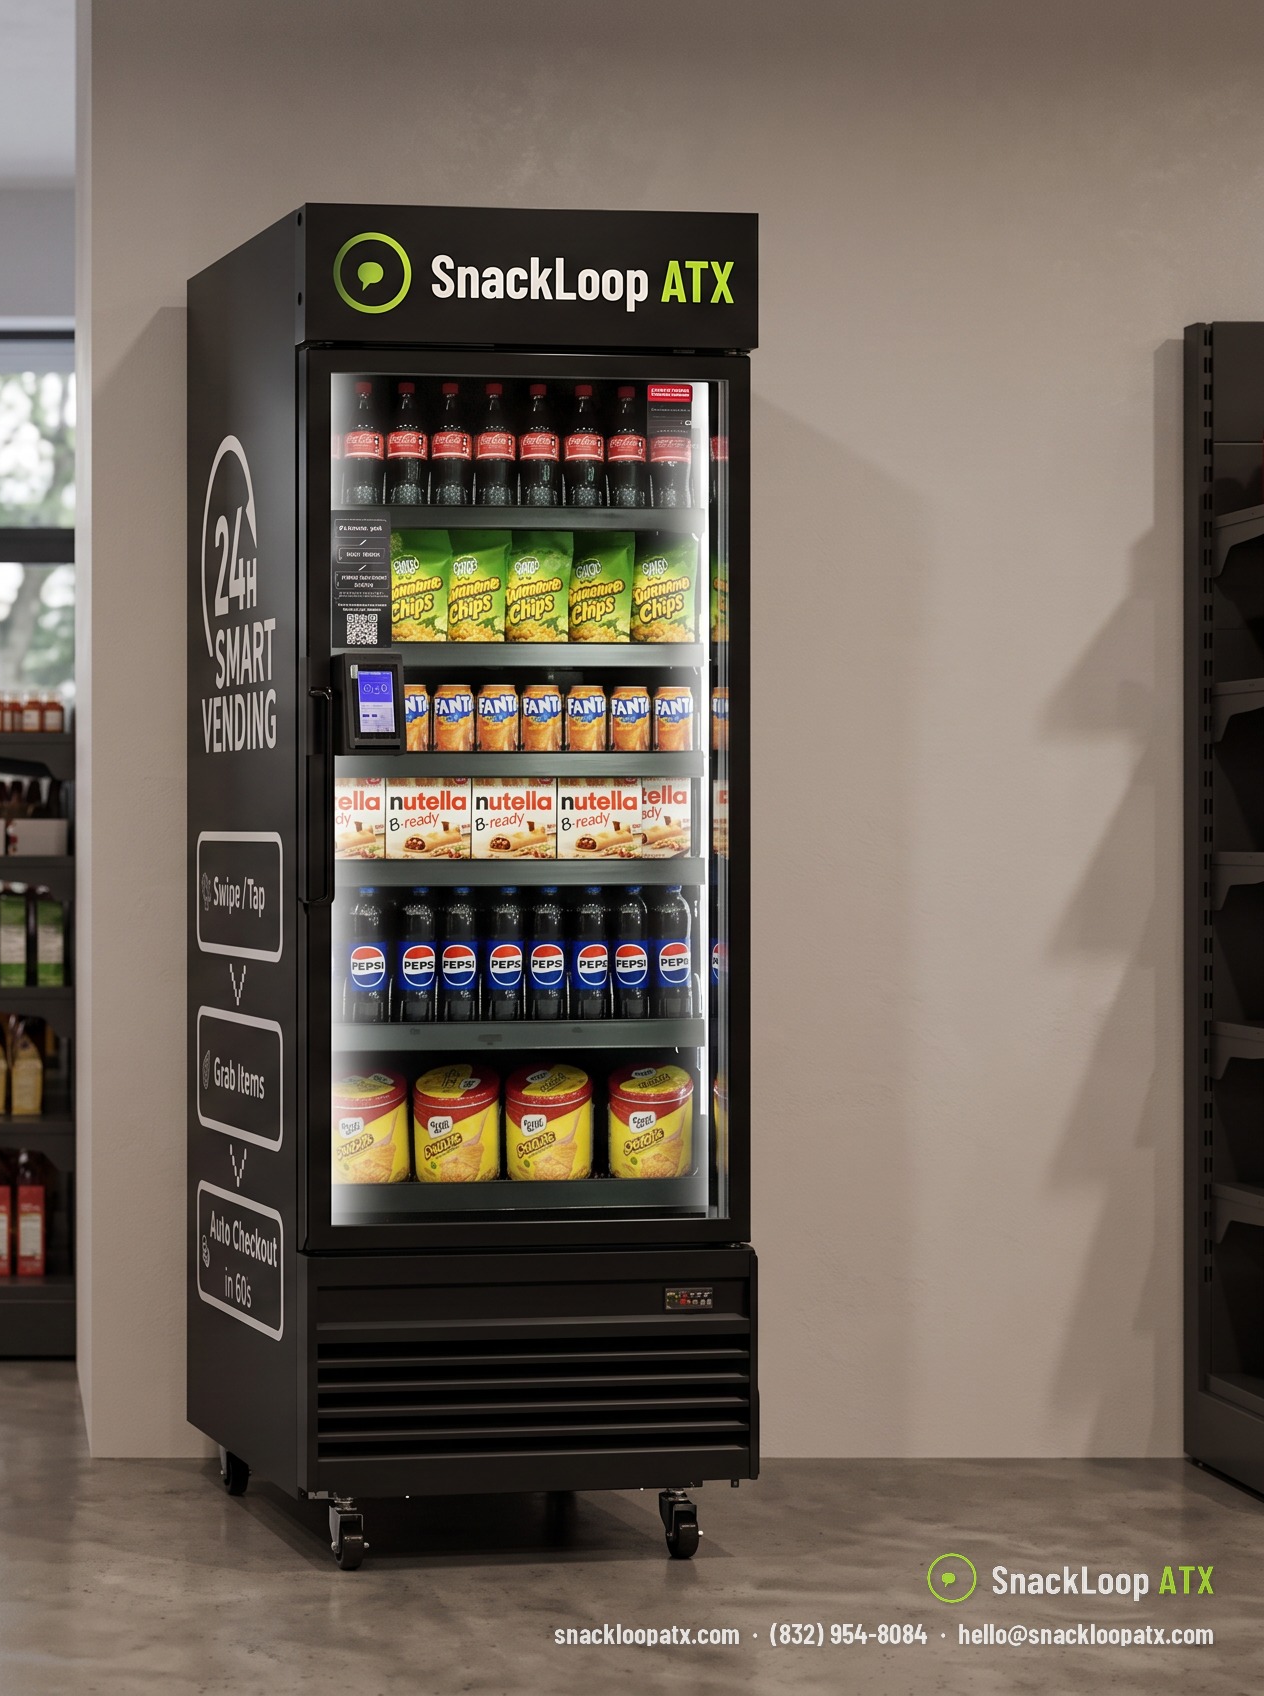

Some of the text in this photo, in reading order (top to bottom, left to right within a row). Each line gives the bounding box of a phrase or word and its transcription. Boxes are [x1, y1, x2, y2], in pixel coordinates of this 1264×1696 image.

[431, 254, 735, 312] SnackLoop ATX
[214, 505, 257, 617] 24H
[448, 594, 493, 625] Chips
[509, 594, 554, 625] Chips
[639, 593, 684, 624] Chips
[215, 617, 276, 690] SMART
[201, 688, 277, 754] VENDING
[335, 791, 380, 811] ella
[390, 791, 467, 811] nutella
[476, 791, 552, 811] nutella
[561, 791, 637, 811] nutella
[389, 813, 440, 832] B-ready
[475, 813, 525, 832] B-ready
[214, 876, 240, 915] Swipe
[352, 961, 384, 971] PEPSI
[214, 1056, 265, 1100] Grab Items
[209, 1210, 278, 1268] Auto Checkout
[225, 1267, 252, 1309] in 60s
